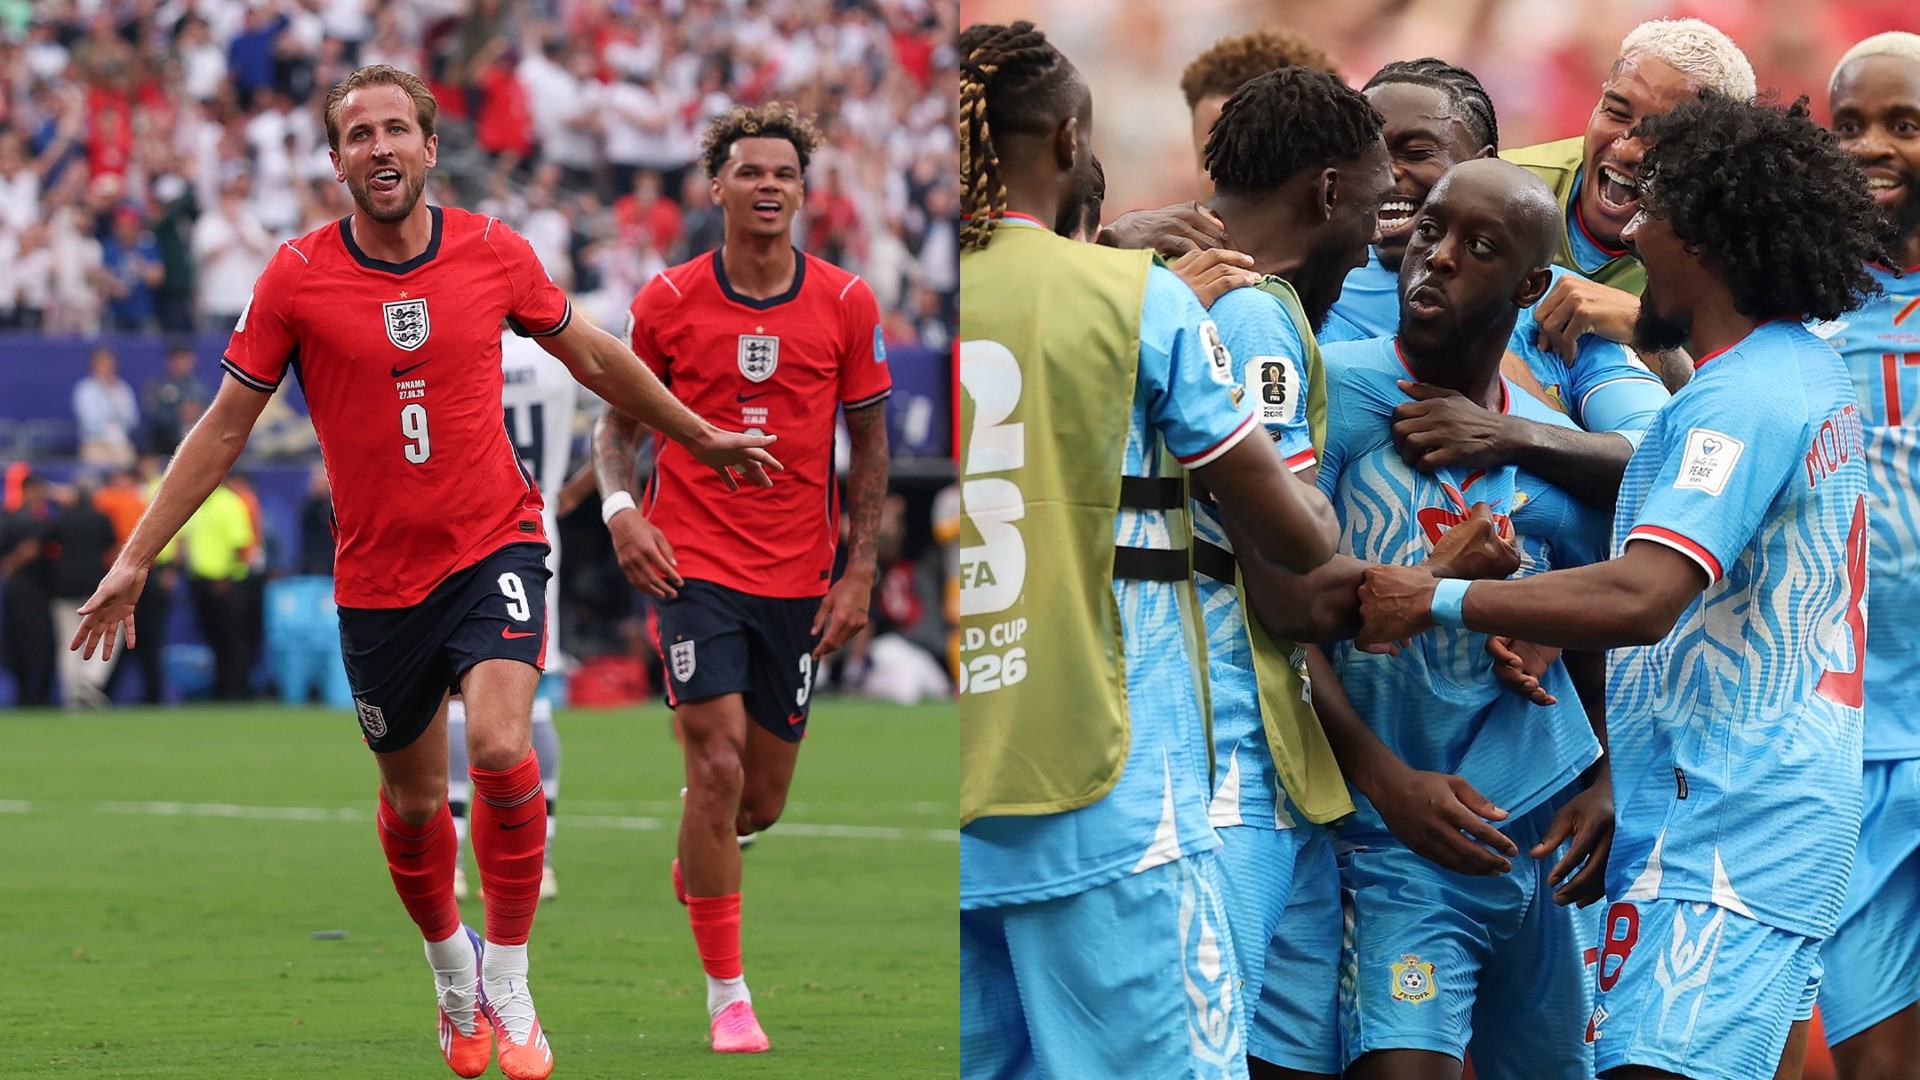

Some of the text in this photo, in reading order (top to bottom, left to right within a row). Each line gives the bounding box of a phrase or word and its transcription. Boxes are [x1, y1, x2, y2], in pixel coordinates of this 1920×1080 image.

[396, 379, 426, 391] PANAMA
[401, 403, 431, 465] 9
[1689, 465, 1713, 478] PEACE
[497, 572, 531, 622] 9
[990, 617, 1028, 648] CUP
[796, 652, 811, 706] 3
[1599, 902, 1640, 993] 8
[1398, 991, 1430, 1000] FECOFA
